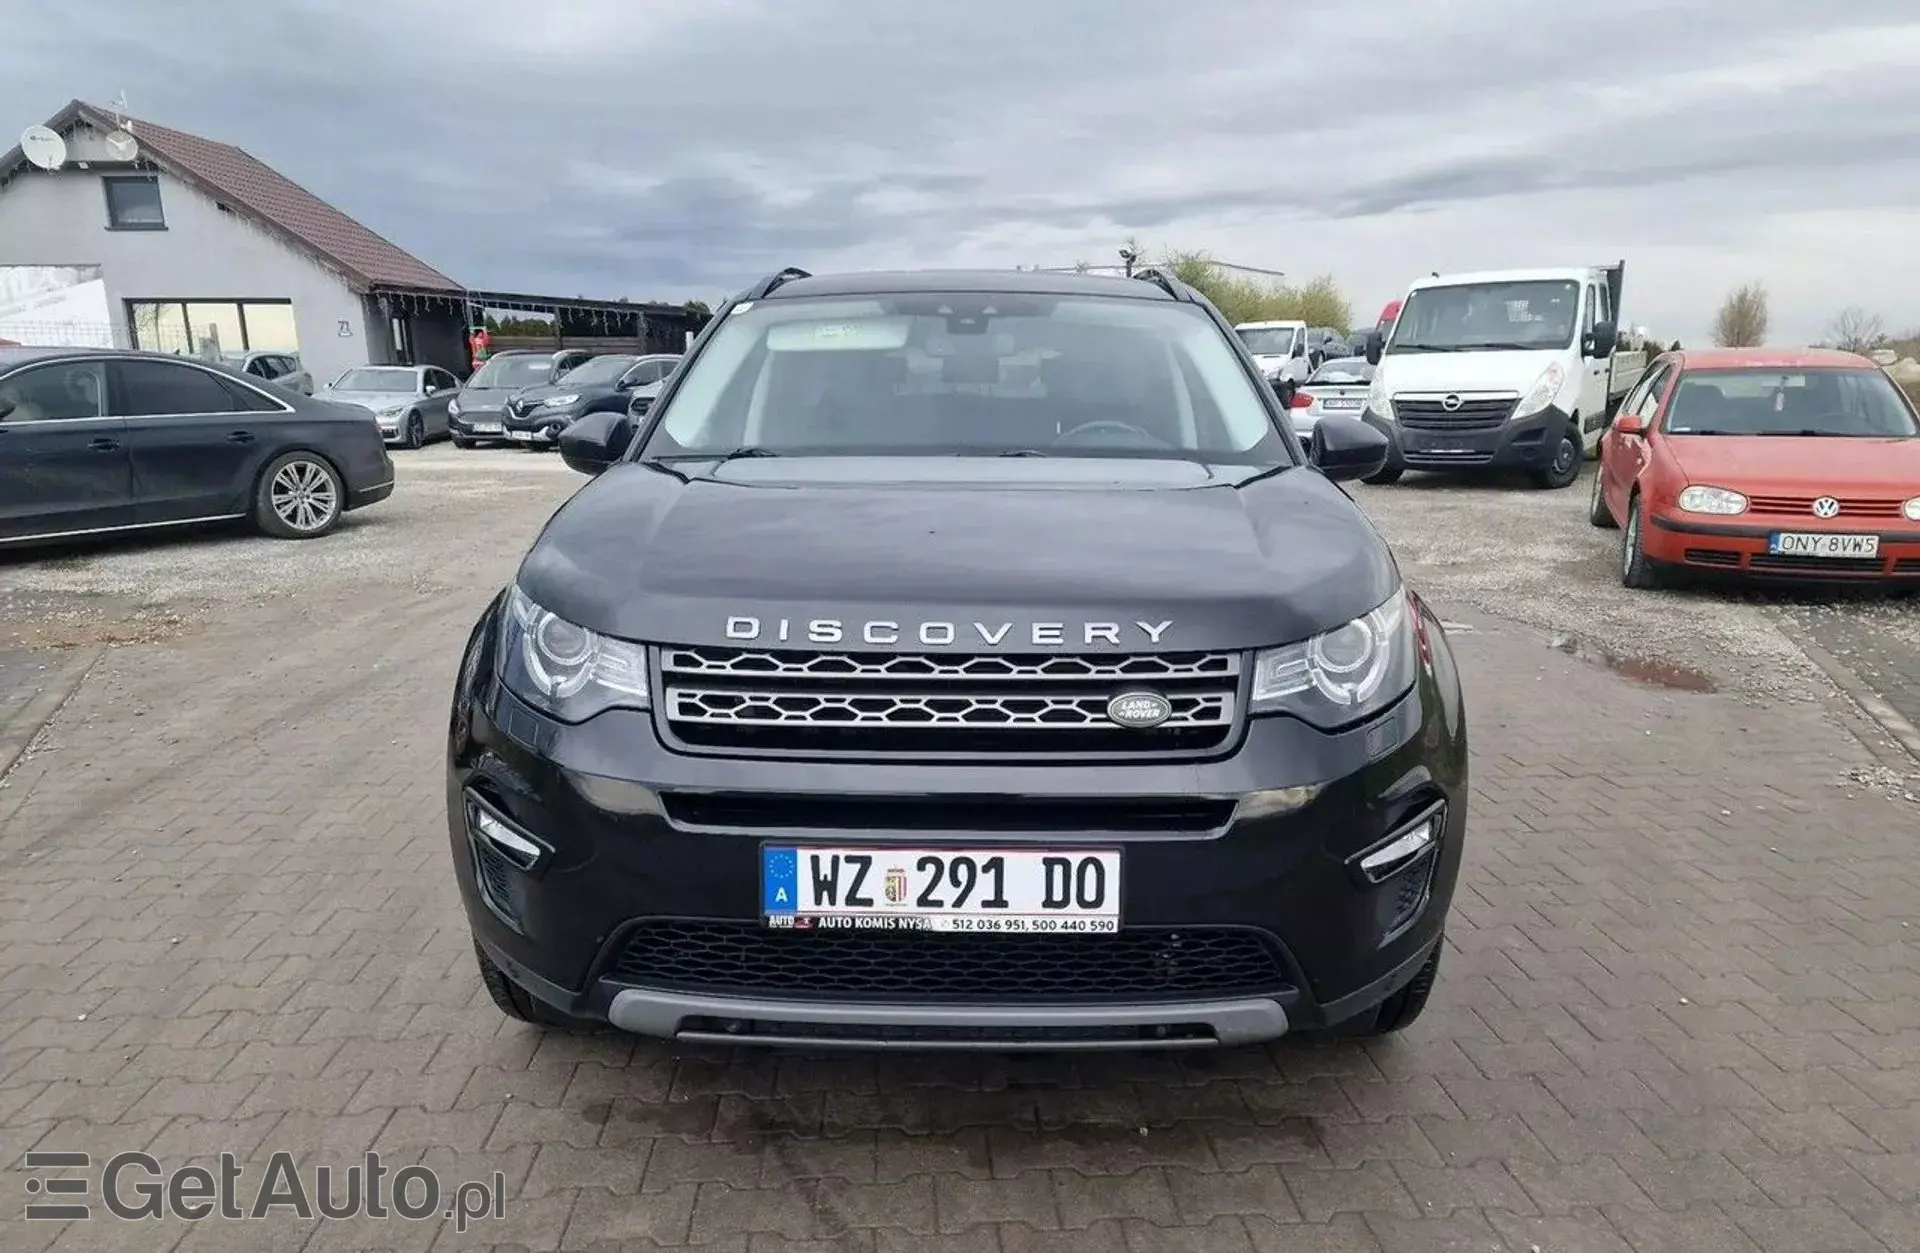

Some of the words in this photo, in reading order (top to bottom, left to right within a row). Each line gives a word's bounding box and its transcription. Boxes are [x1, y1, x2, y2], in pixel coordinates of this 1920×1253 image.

[1782, 535, 1822, 552] ONY
[725, 616, 1173, 646] DISCOVERY
[1121, 700, 1150, 709] LAND
[1125, 708, 1160, 719] ROVER
[809, 854, 875, 907] WZ
[915, 855, 1009, 909] 291
[774, 887, 788, 903] A
[769, 915, 794, 926] AUTO
[818, 916, 851, 929] AUTO
[854, 917, 896, 930] KOMIS
[952, 919, 973, 930] 512
[976, 919, 1001, 931] 036
[1032, 920, 1057, 931] 500
[1060, 921, 1086, 931] 440
[1090, 920, 1114, 931] 590
